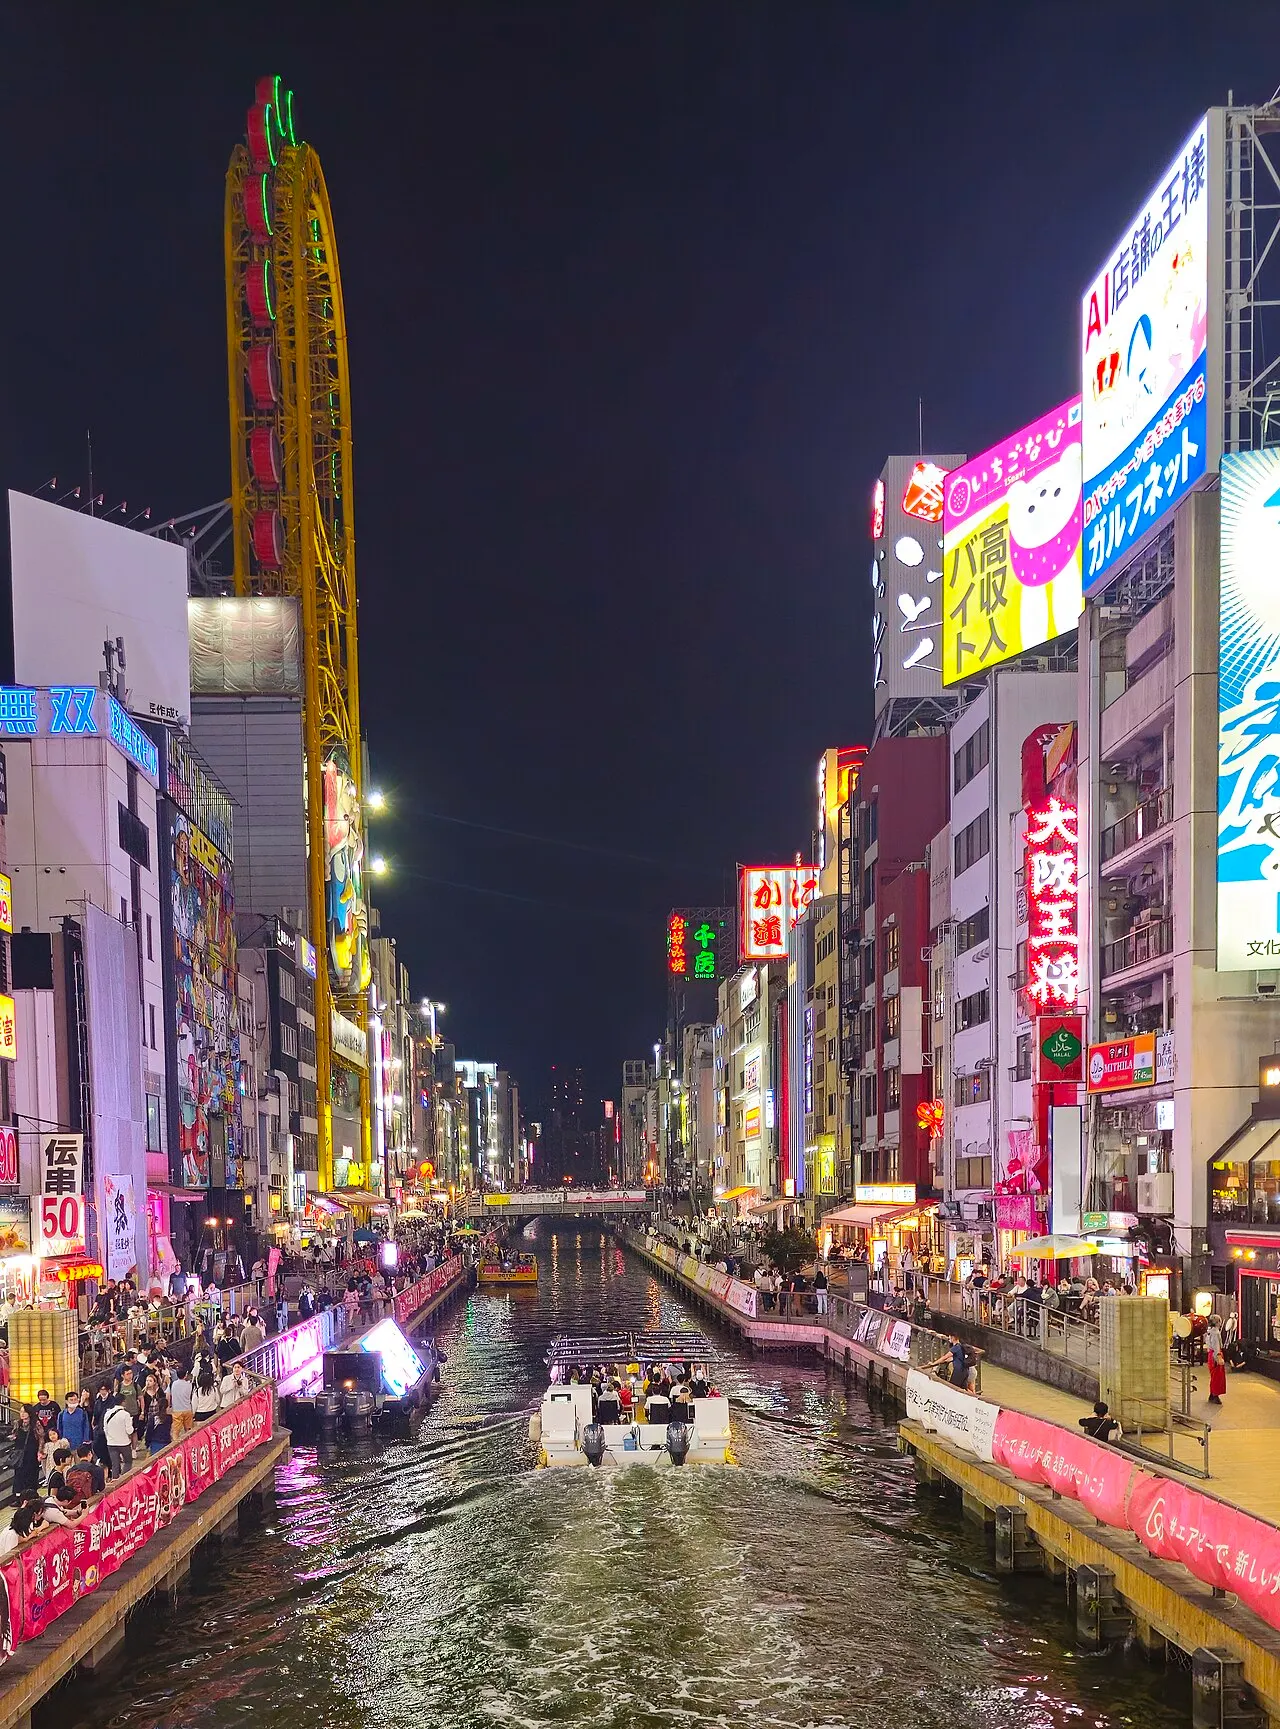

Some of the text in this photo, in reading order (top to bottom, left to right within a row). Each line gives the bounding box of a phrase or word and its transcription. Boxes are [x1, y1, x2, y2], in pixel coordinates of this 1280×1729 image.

[971, 418, 1066, 493] いちごなび
[1088, 426, 1199, 577] ガルフネット
[948, 533, 980, 675] バイト
[979, 518, 1009, 663] 高収入
[753, 878, 818, 911] かに
[1025, 795, 1078, 1005] 大阪王将
[671, 915, 686, 972] お好み焼
[694, 924, 716, 973] 千房
[1051, 1041, 1072, 1053] حلال
[1104, 1060, 1133, 1073] MITHILA
[45, 1139, 79, 1196] 伝串
